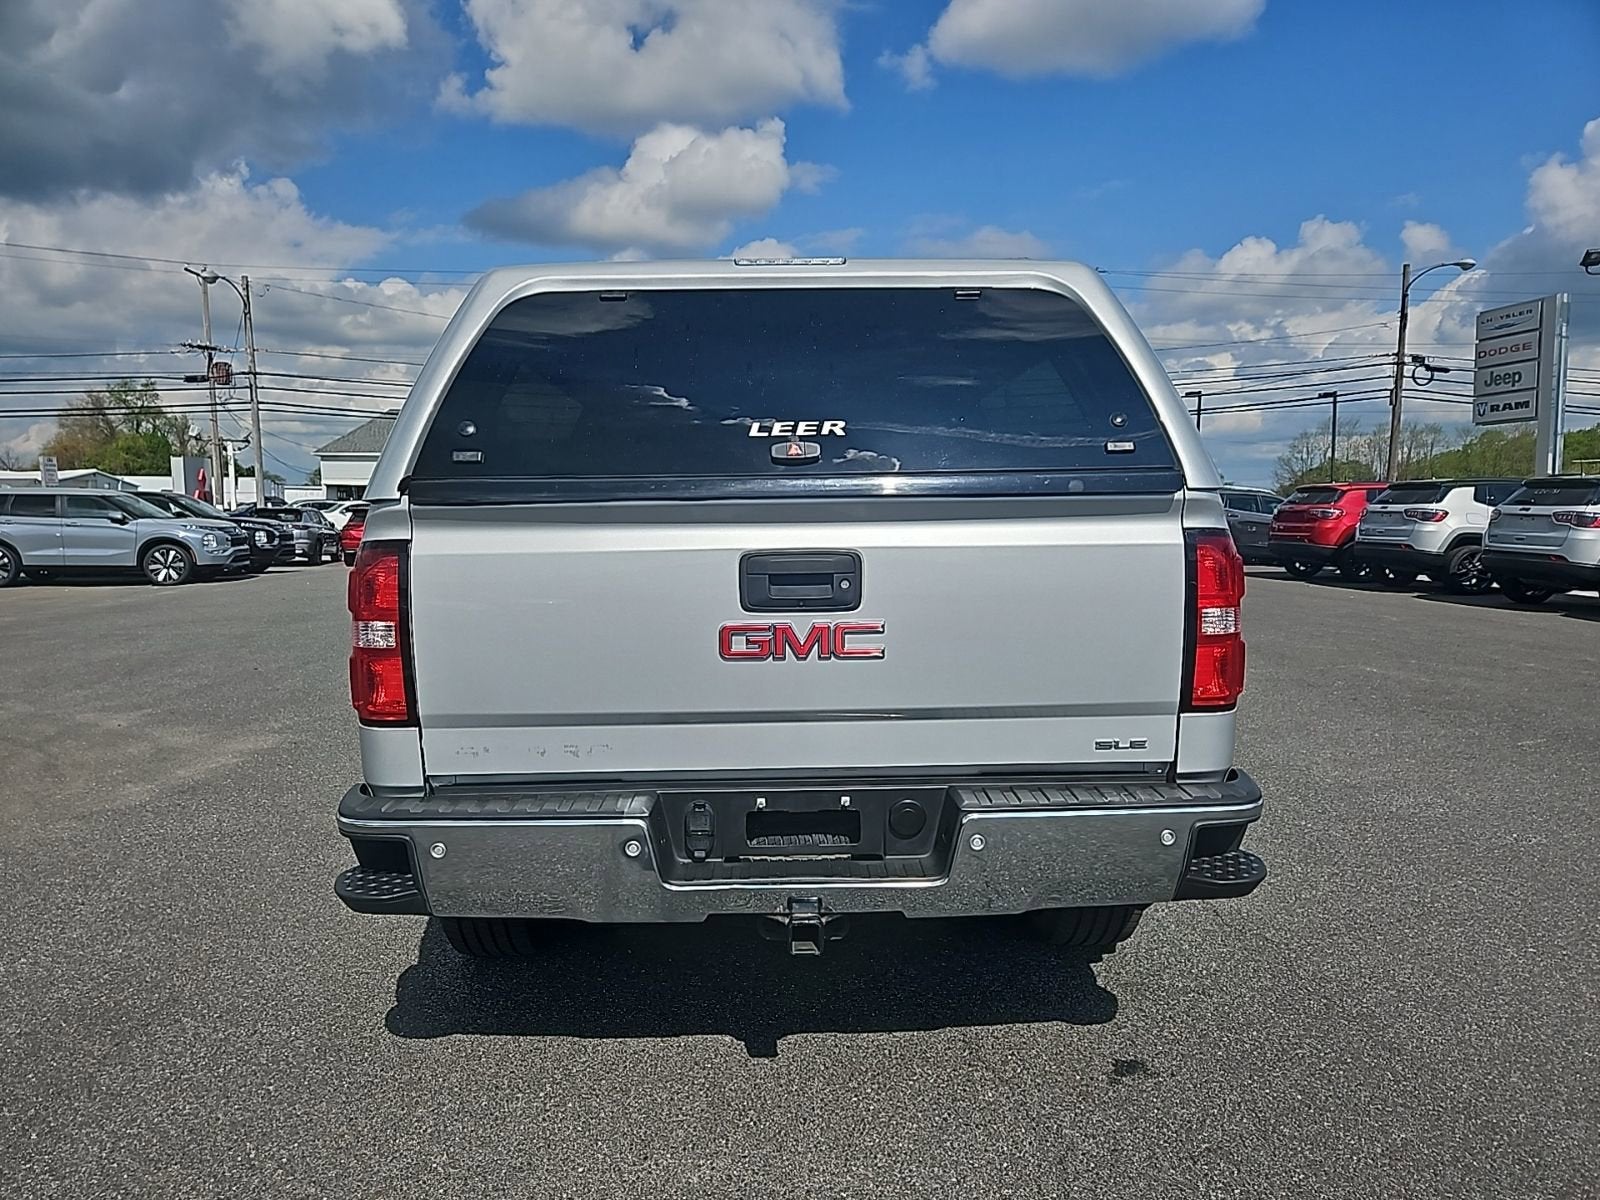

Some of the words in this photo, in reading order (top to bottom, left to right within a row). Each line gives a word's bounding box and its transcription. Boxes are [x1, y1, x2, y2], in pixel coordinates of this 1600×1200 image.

[1478, 342, 1533, 359] DODGE
[1484, 371, 1522, 387] Jeep
[1489, 400, 1530, 412] RAM
[748, 420, 846, 437] LEER
[718, 619, 886, 662] GMC
[1094, 738, 1148, 751] SLE
